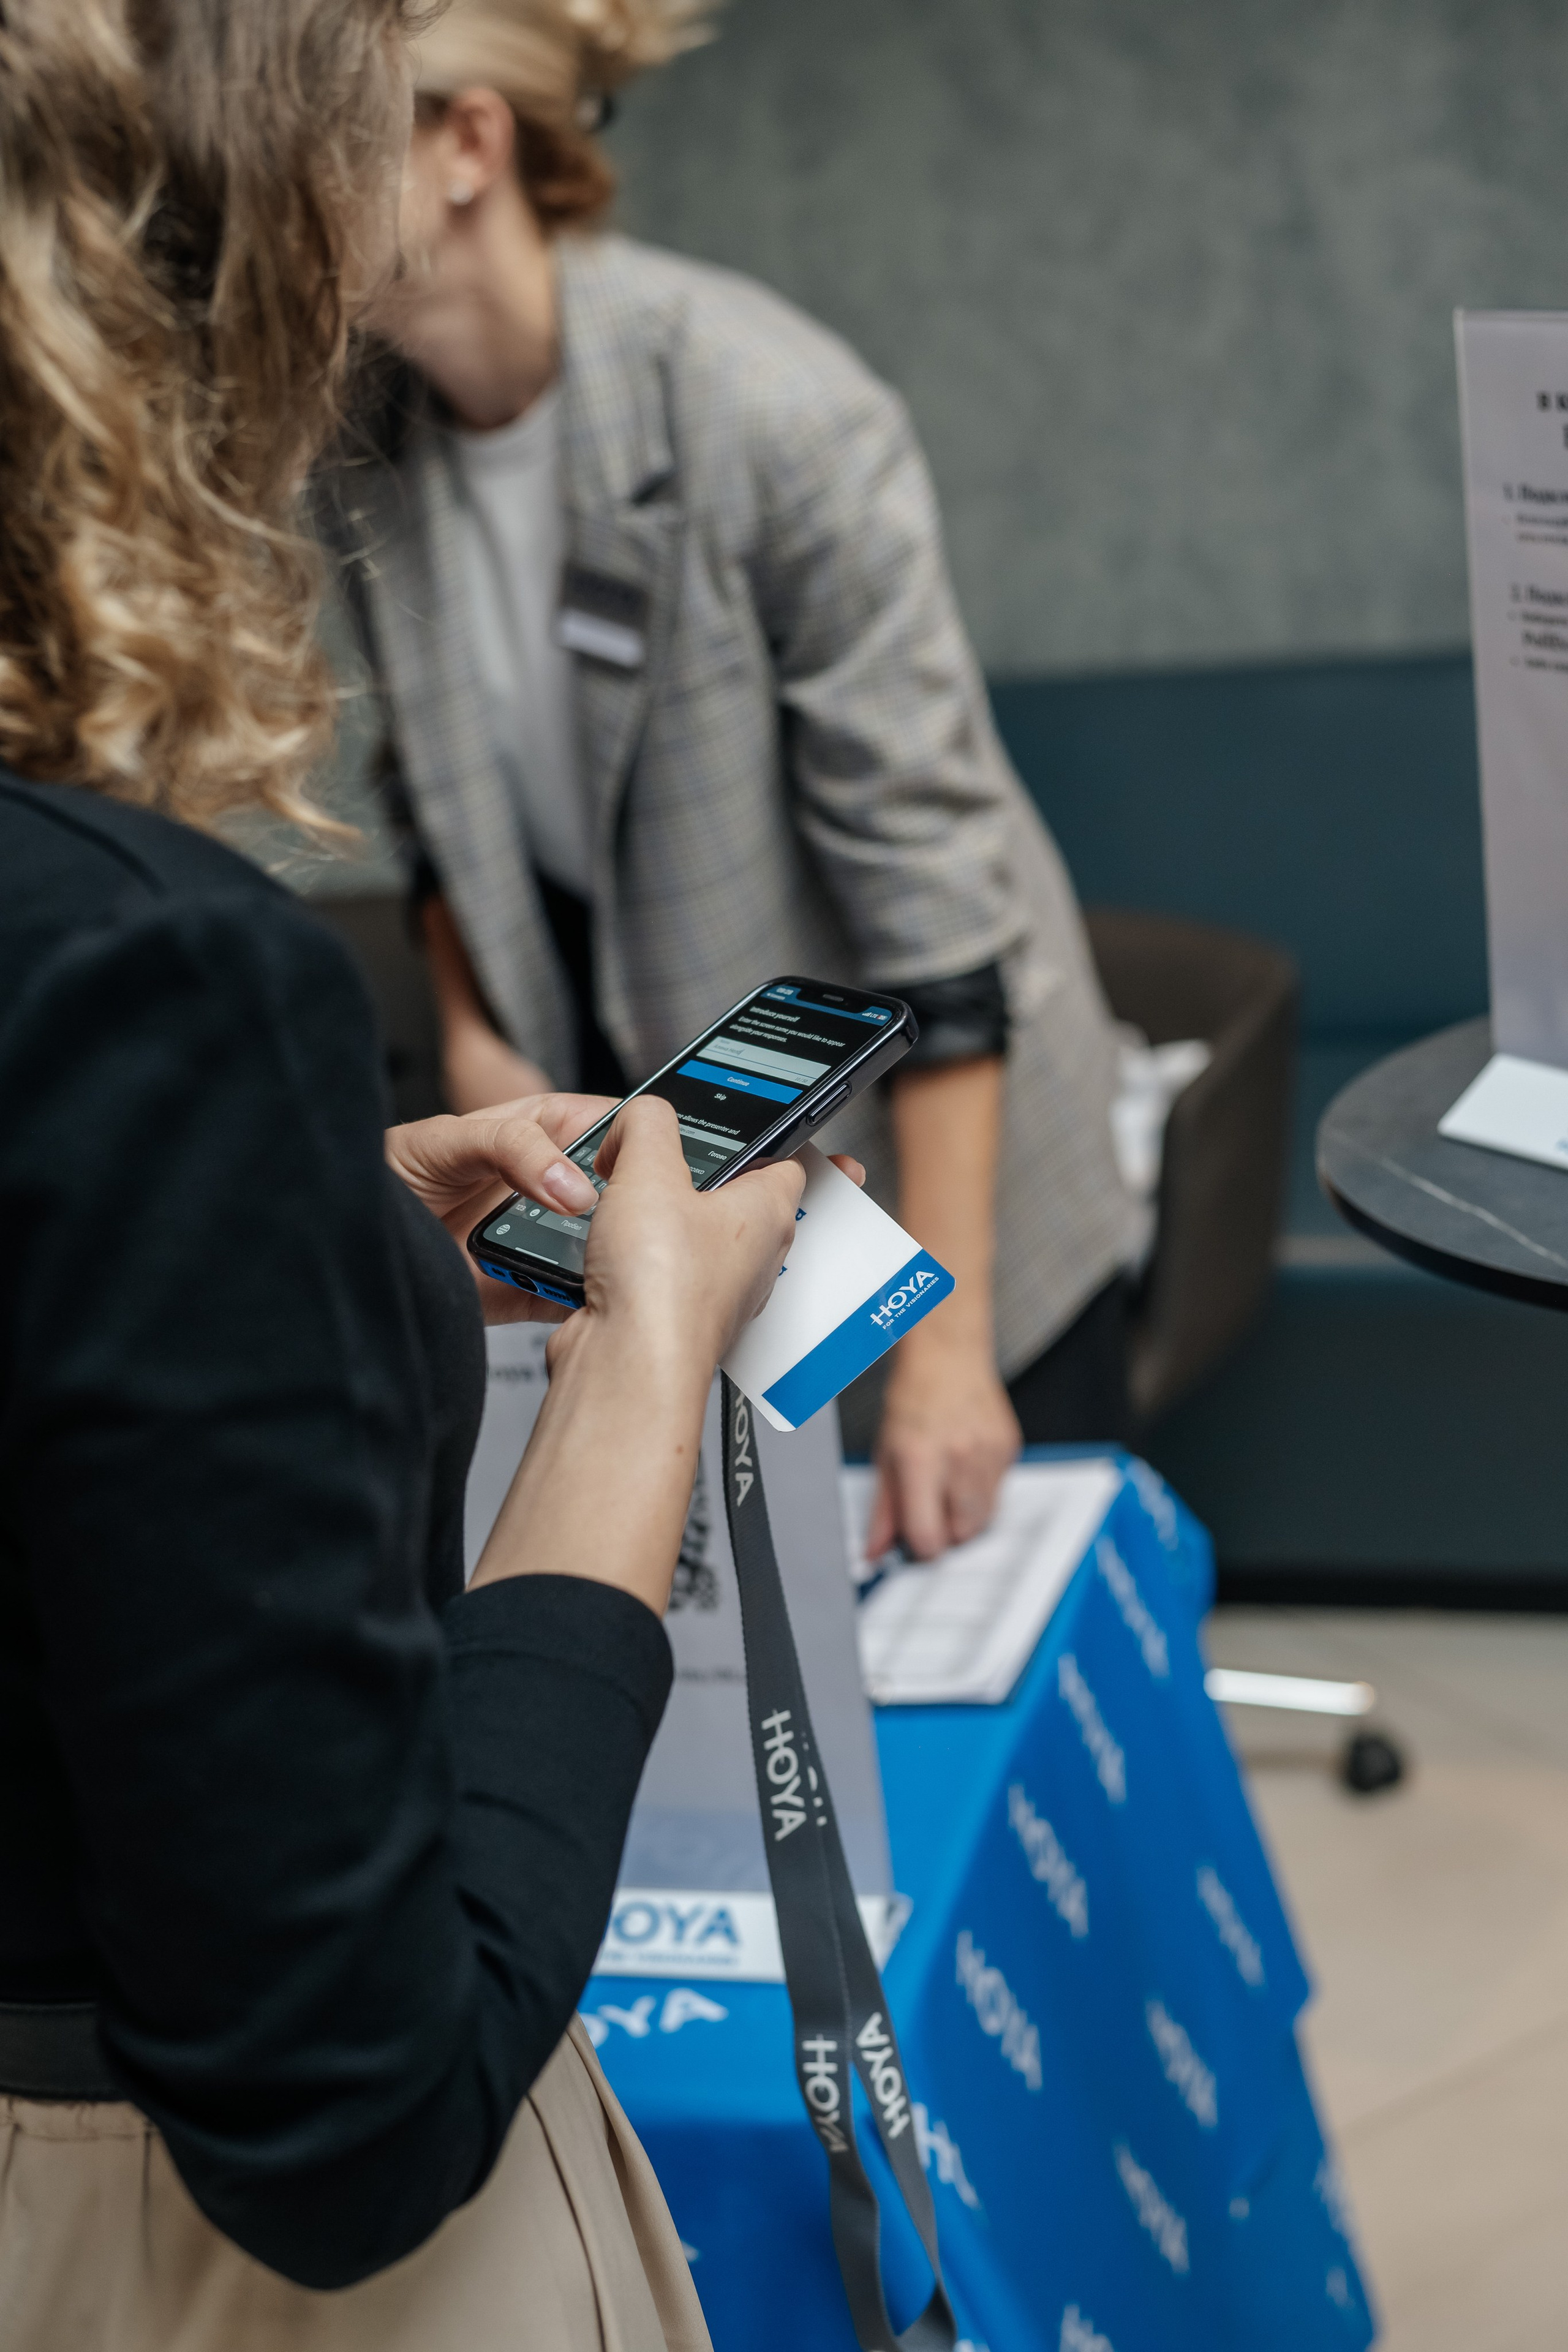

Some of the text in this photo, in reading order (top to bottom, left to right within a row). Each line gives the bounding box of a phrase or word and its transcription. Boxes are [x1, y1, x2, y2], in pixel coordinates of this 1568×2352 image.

[750, 1006, 801, 1022] Introduce yourself
[729, 1024, 753, 1033] alongside
[762, 1033, 788, 1042] responses.
[727, 1077, 750, 1087] Continue
[704, 1122, 729, 1132] presenter
[707, 1150, 728, 1160] Готово
[688, 1166, 705, 1175] ловко
[561, 1219, 582, 1231] Пробел
[870, 1270, 935, 1325] HOYA
[882, 1276, 940, 1330] FOR THE VISIONARIES
[761, 1708, 807, 1841] HOYA
[612, 1901, 740, 1946] OYA
[580, 1987, 729, 2049] YA
[856, 2011, 910, 2139] HOYA
